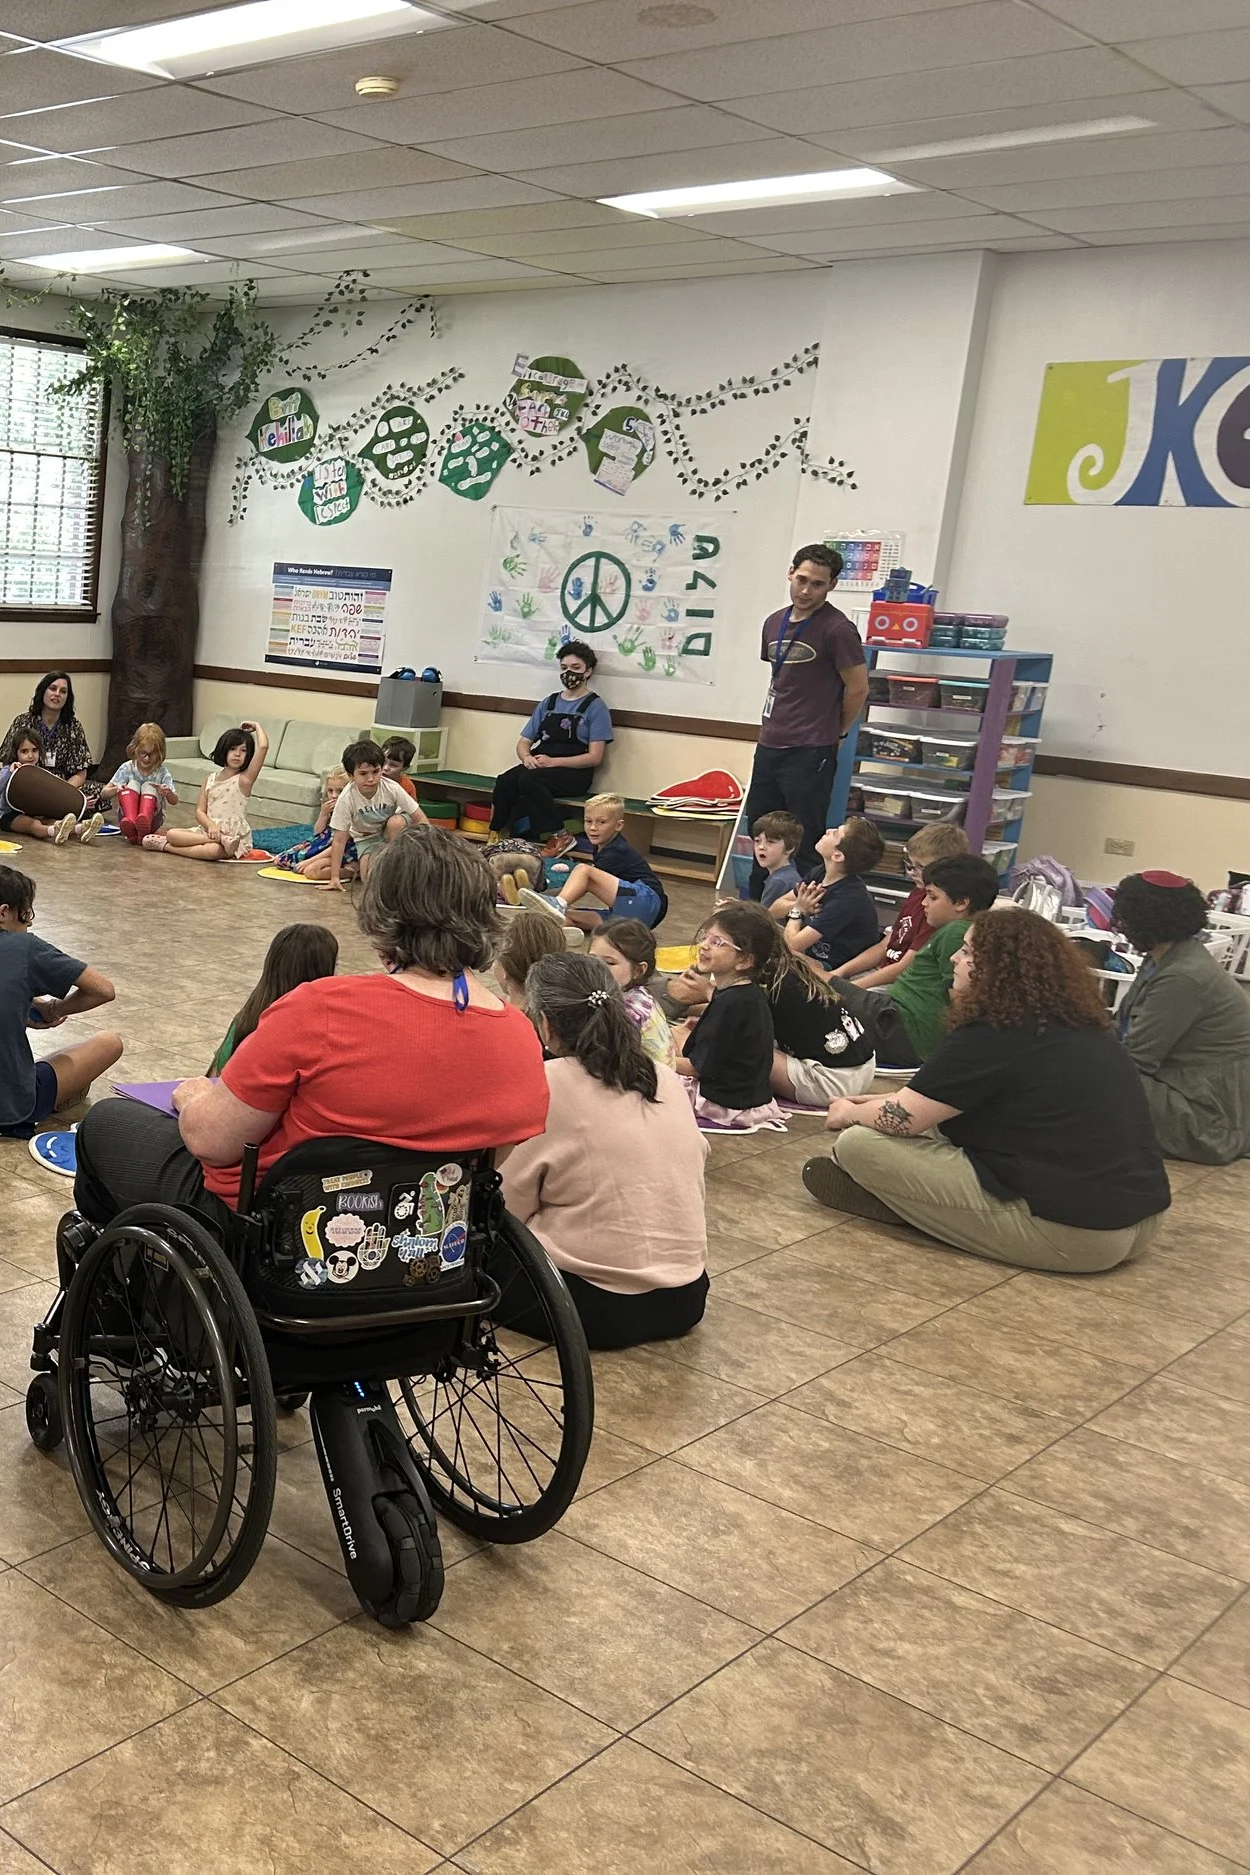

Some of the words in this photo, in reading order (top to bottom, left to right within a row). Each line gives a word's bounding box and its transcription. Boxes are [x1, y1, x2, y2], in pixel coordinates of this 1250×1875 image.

[291, 624, 307, 633] KEF
[95, 1489, 150, 1571] SPINEGY
[332, 1487, 358, 1560] SmartDrive
